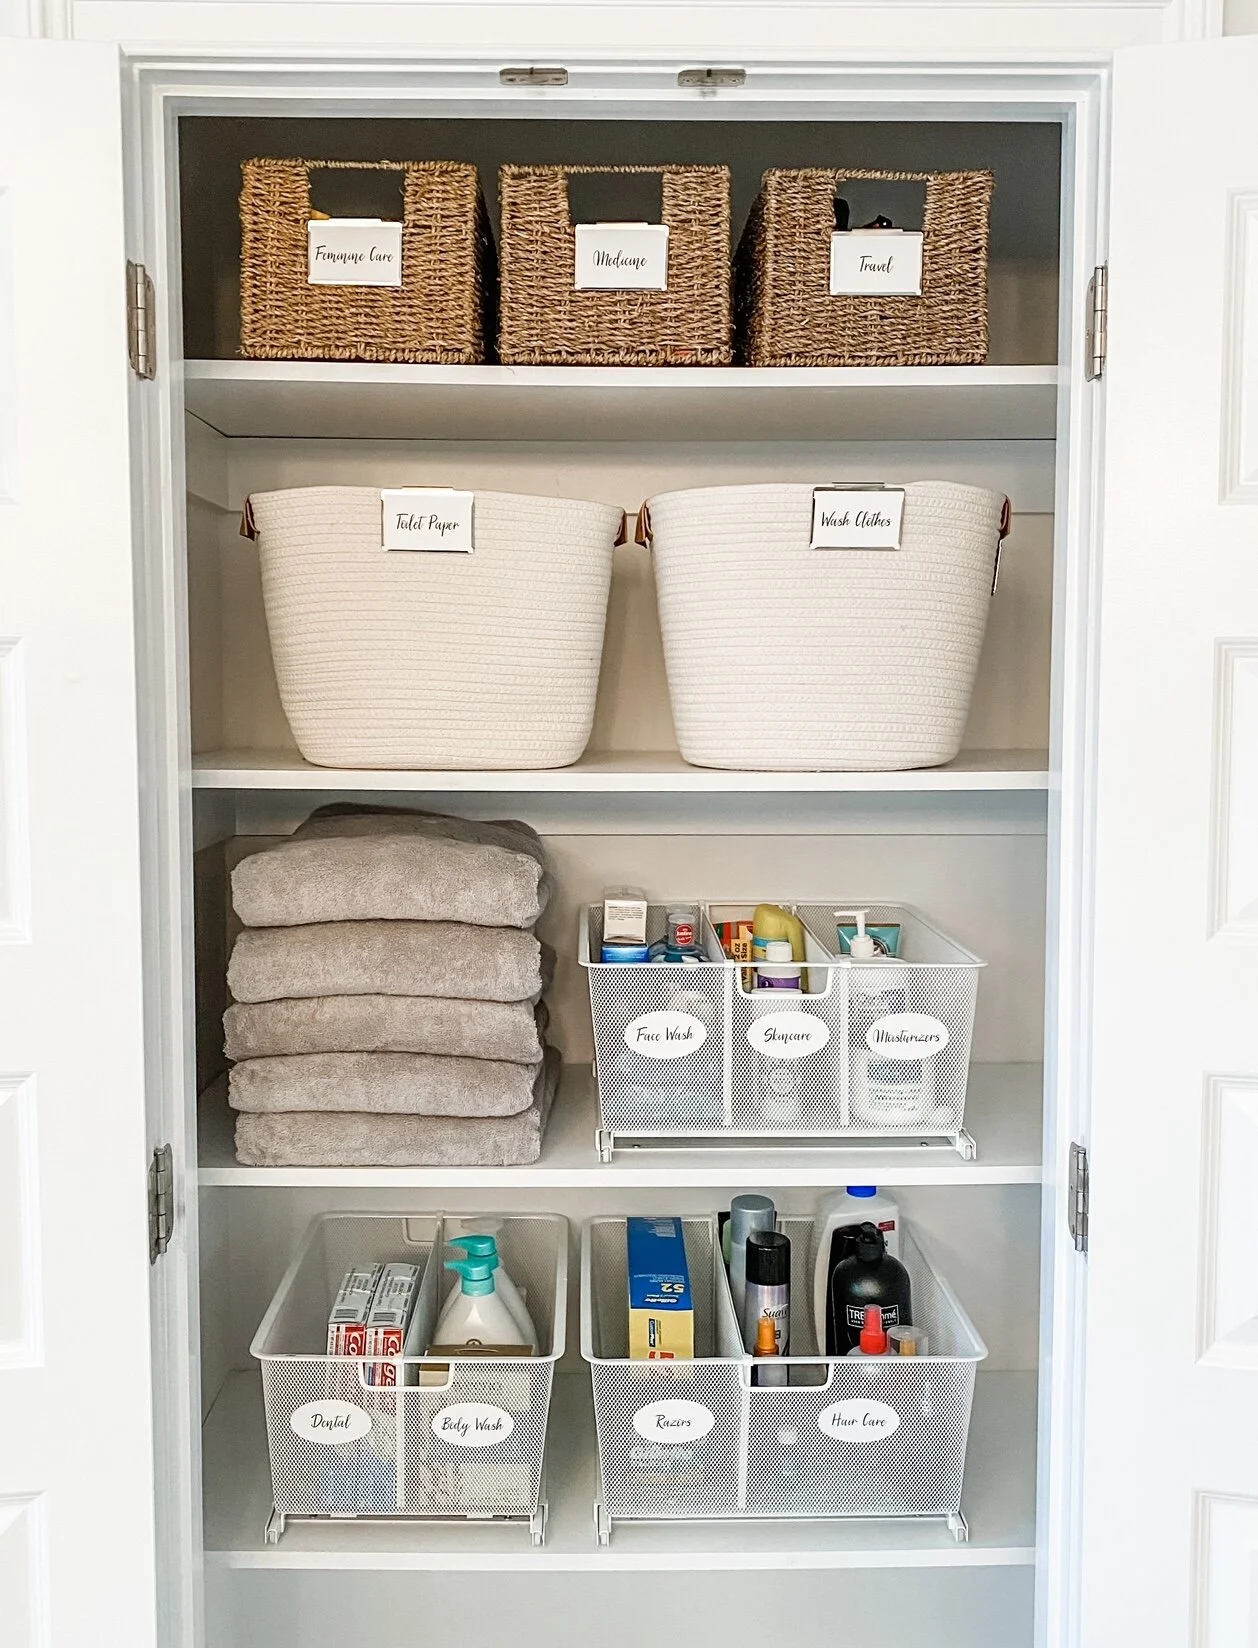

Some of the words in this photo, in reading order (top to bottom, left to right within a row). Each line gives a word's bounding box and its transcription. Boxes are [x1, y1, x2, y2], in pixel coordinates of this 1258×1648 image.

[315, 244, 366, 265] Feminine
[369, 245, 394, 263] Care
[592, 249, 649, 271] Medicine
[859, 255, 894, 274] Travel
[396, 512, 428, 532] Toilet
[428, 513, 460, 537] Paper
[821, 510, 850, 528] Wash
[855, 510, 892, 529] Clothes
[636, 1026, 662, 1042] Face
[666, 1025, 694, 1041] Wash
[764, 1026, 813, 1045] Skincare
[872, 1028, 941, 1044] Moisturizers
[661, 1282, 685, 1293] 52
[311, 1413, 352, 1431] Dental
[441, 1416, 471, 1438] Body
[475, 1416, 505, 1431] Wash
[655, 1414, 692, 1430] Razors
[831, 1412, 858, 1427] Hair
[862, 1412, 888, 1427] Care
